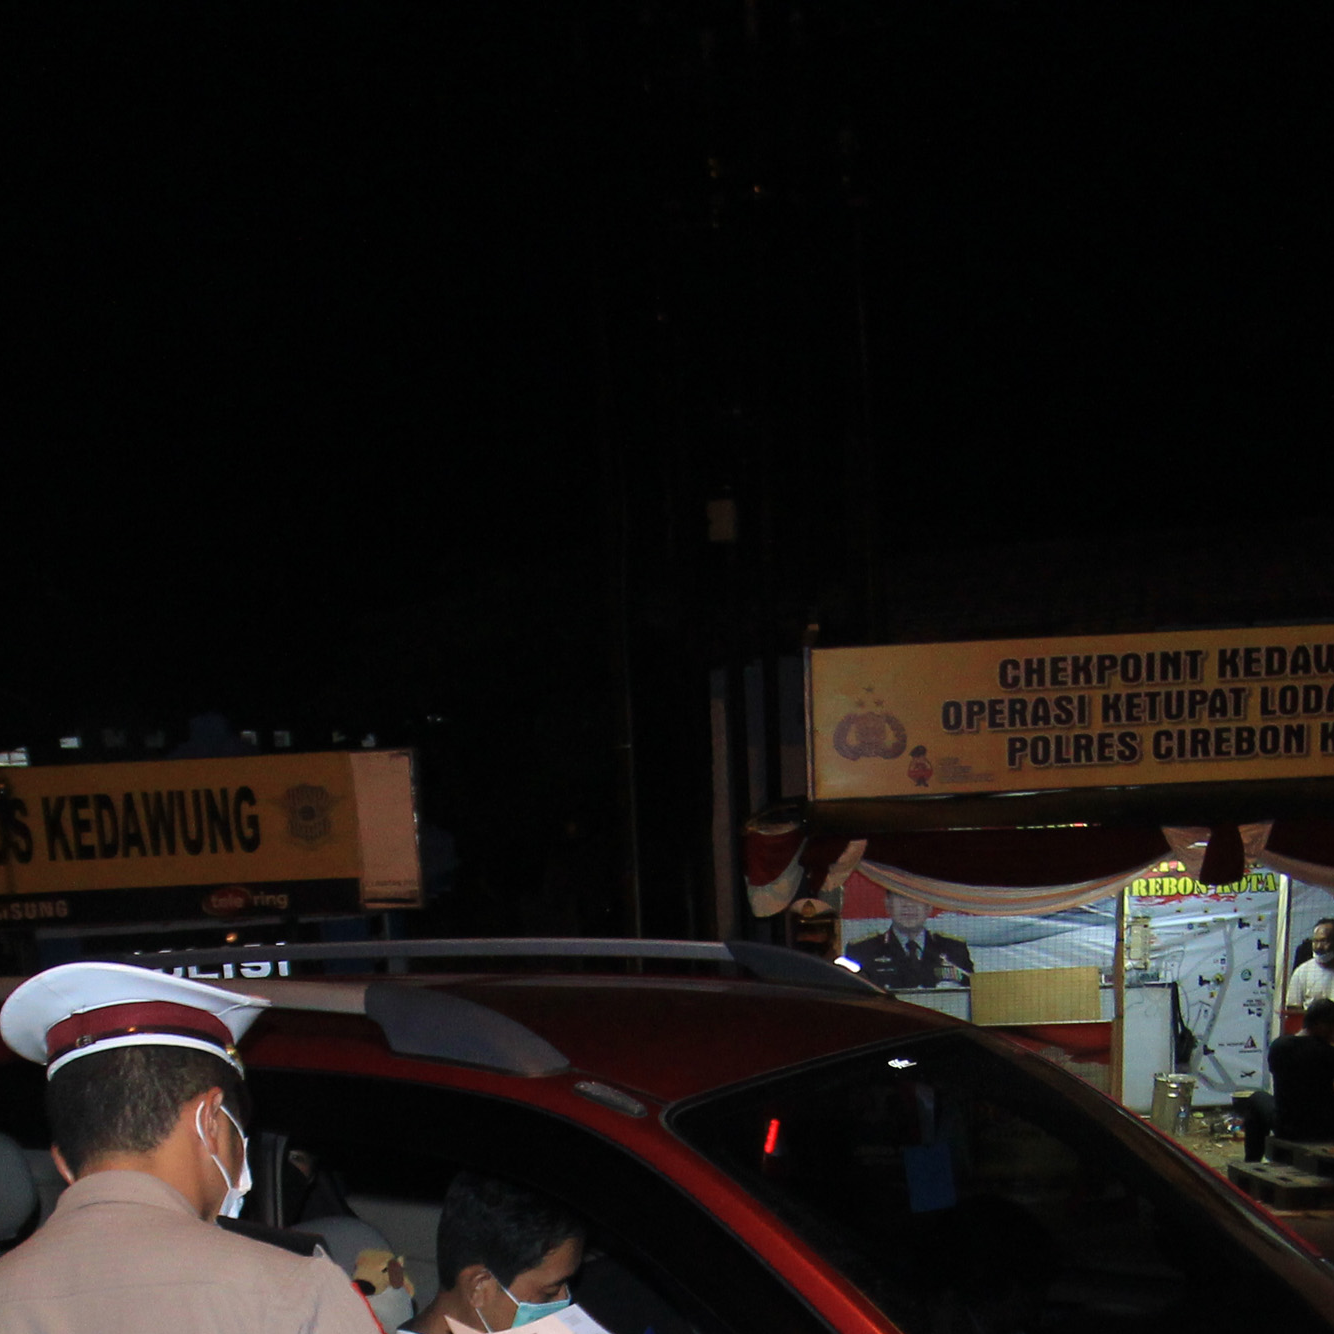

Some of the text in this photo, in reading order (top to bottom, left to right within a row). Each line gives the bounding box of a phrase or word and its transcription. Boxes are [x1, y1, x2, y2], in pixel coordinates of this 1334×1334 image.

[999, 650, 1207, 691] CHEKPOINT
[941, 694, 1089, 732] OPERASI
[1101, 687, 1247, 724] KETUPAT
[1007, 731, 1140, 768] POLRES
[1152, 724, 1306, 761] CIREBON
[40, 786, 262, 861] KEDAWUNG
[1131, 876, 1208, 897] REBON
